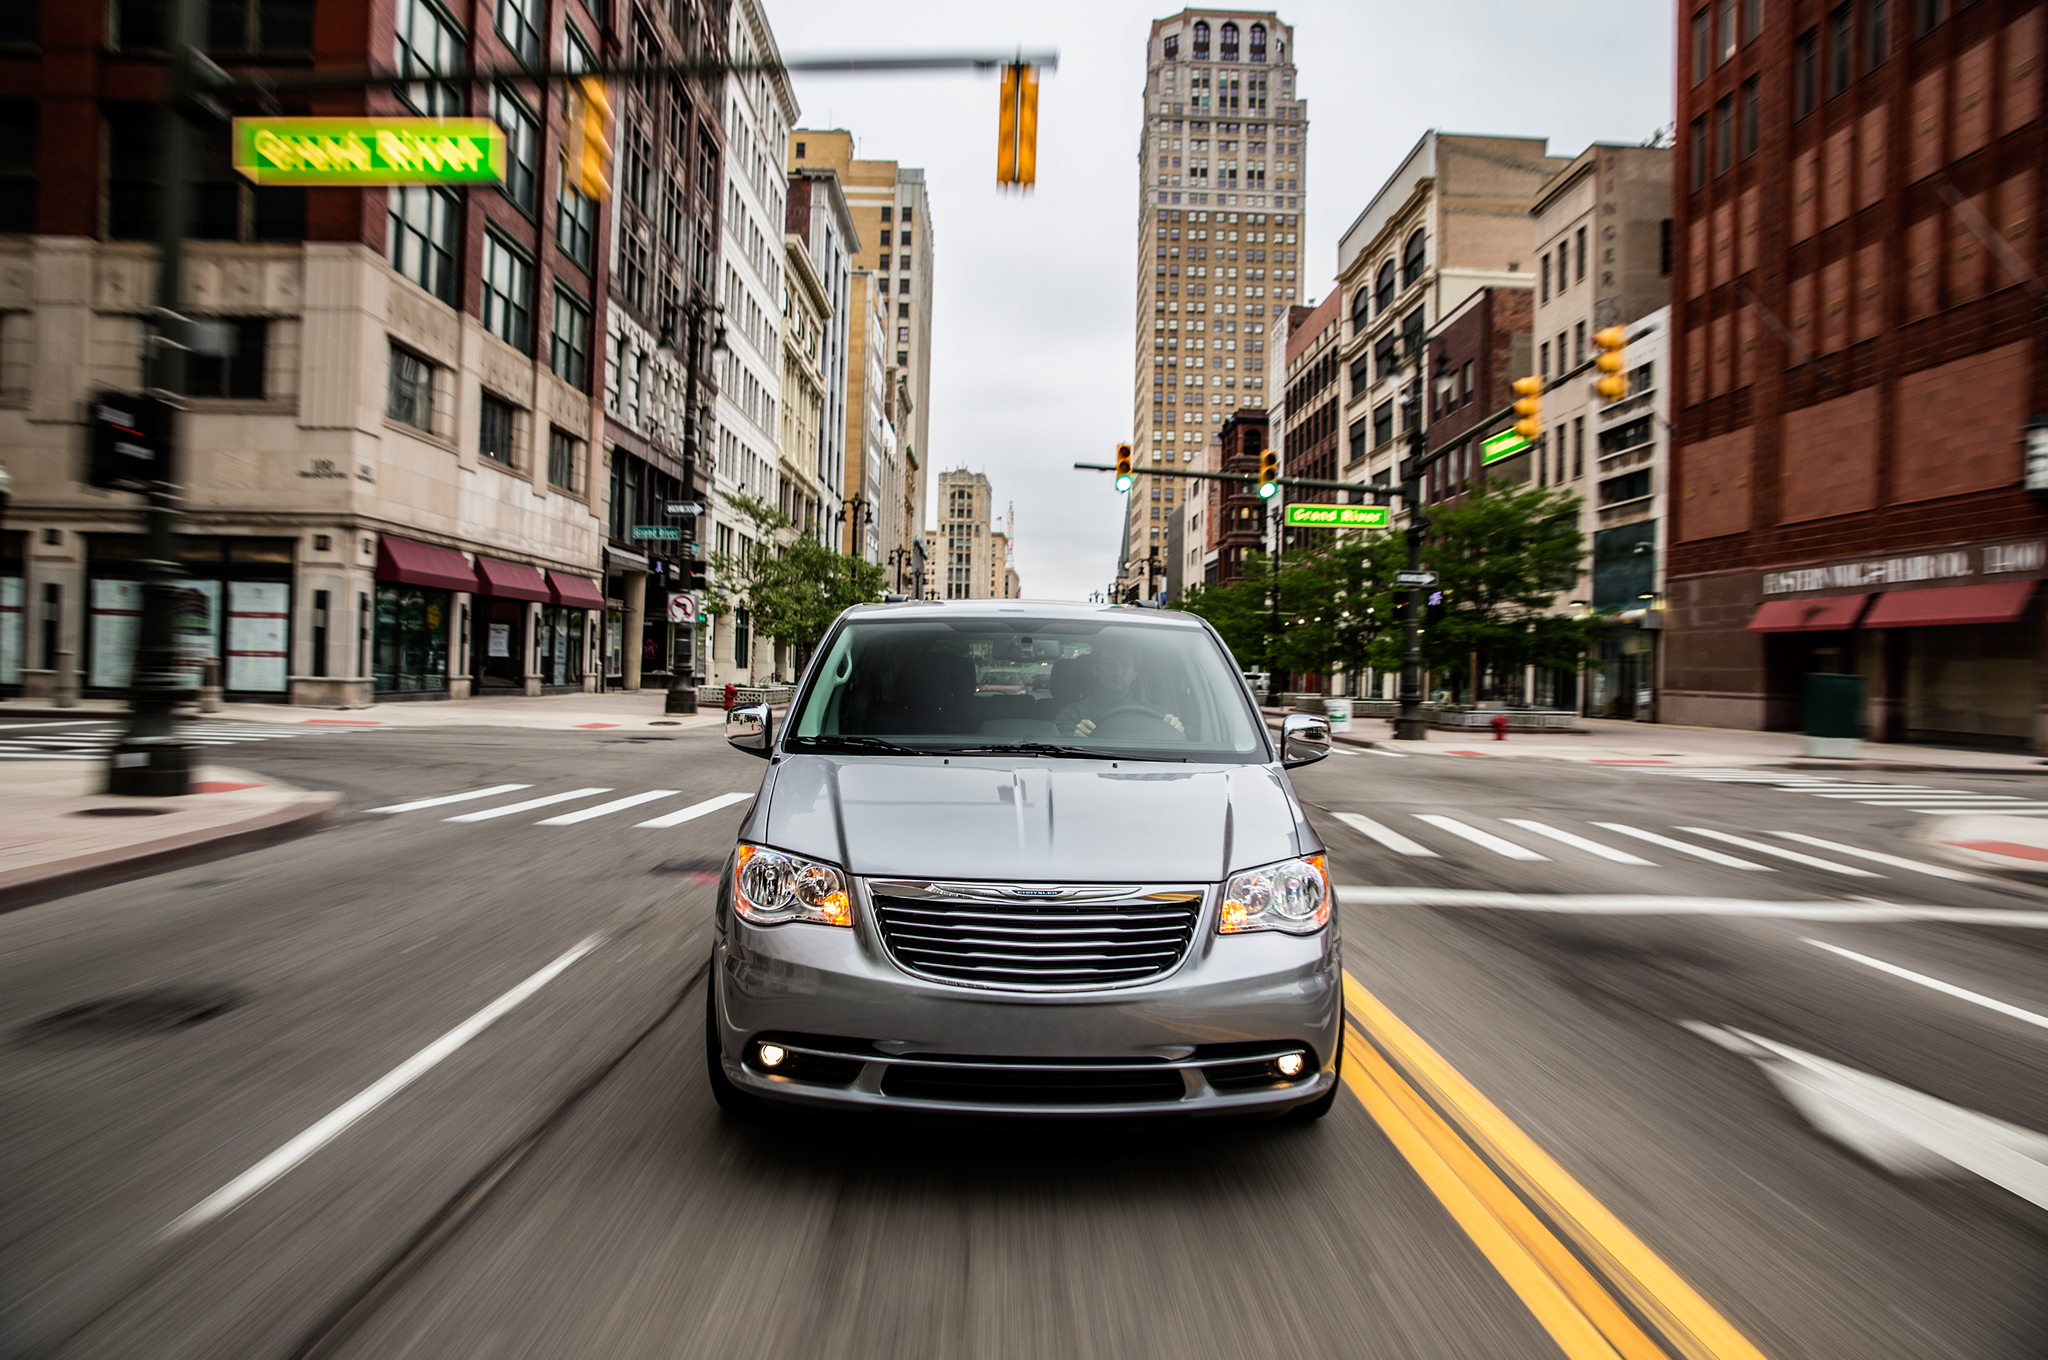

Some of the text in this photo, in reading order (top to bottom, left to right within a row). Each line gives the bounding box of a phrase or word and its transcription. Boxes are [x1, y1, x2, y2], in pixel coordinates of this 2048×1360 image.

[1293, 508, 1382, 523] Grand River
[659, 527, 678, 539] River
